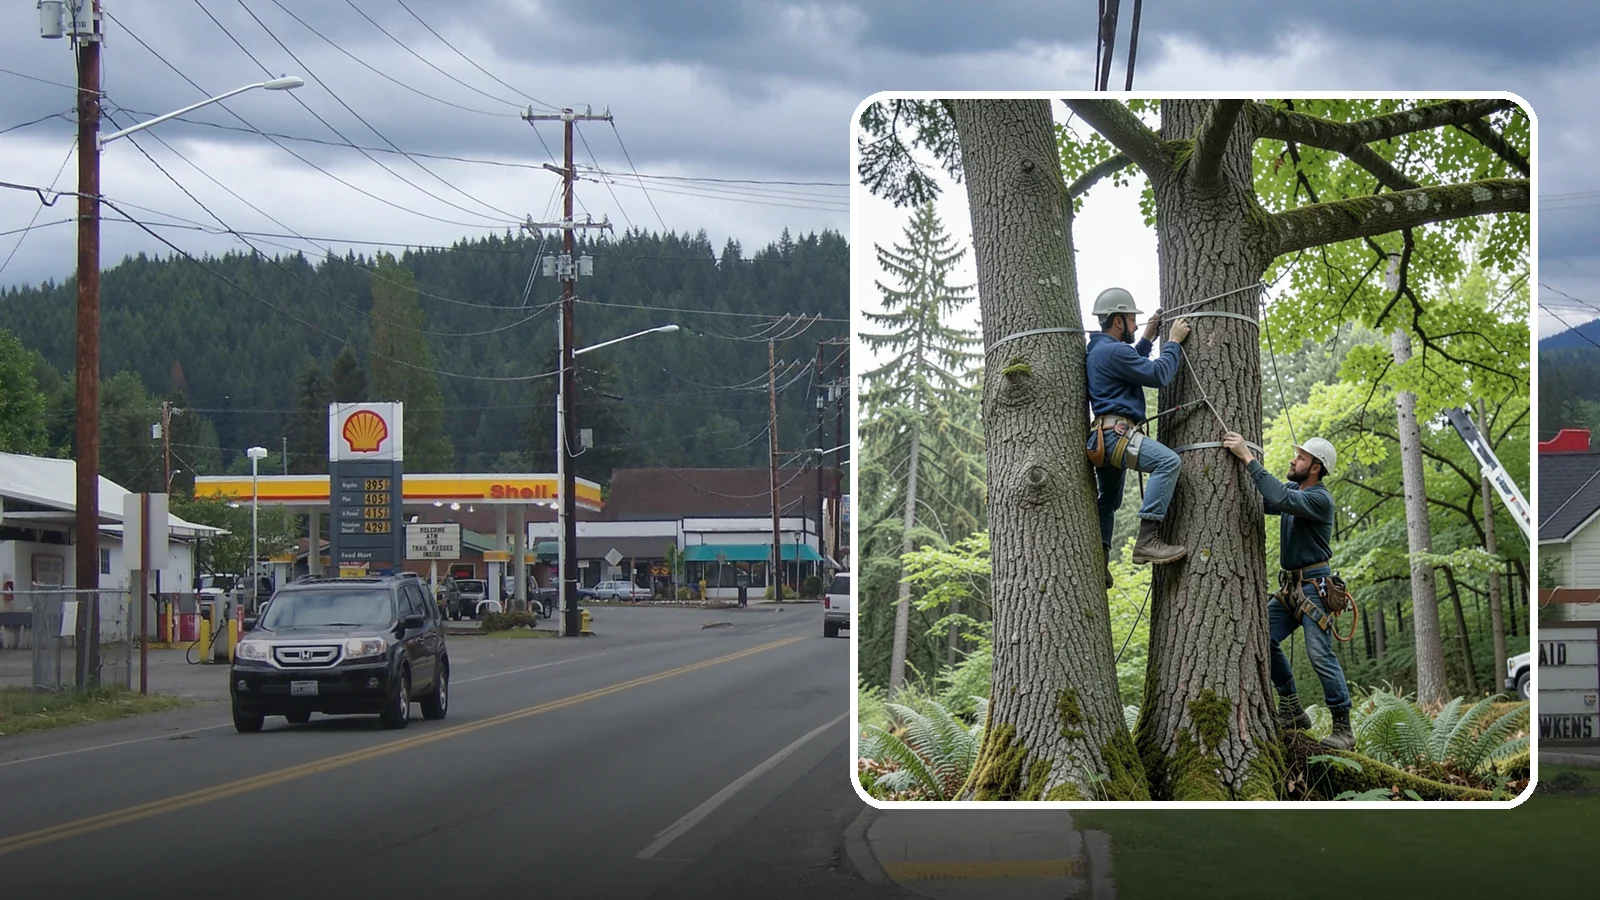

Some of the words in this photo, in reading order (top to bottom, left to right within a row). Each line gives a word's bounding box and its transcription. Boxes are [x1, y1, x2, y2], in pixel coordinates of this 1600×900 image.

[366, 480, 383, 490] 395
[489, 484, 547, 499] Shell
[365, 494, 383, 504] 405
[365, 508, 383, 518] 415
[366, 522, 383, 532] 429
